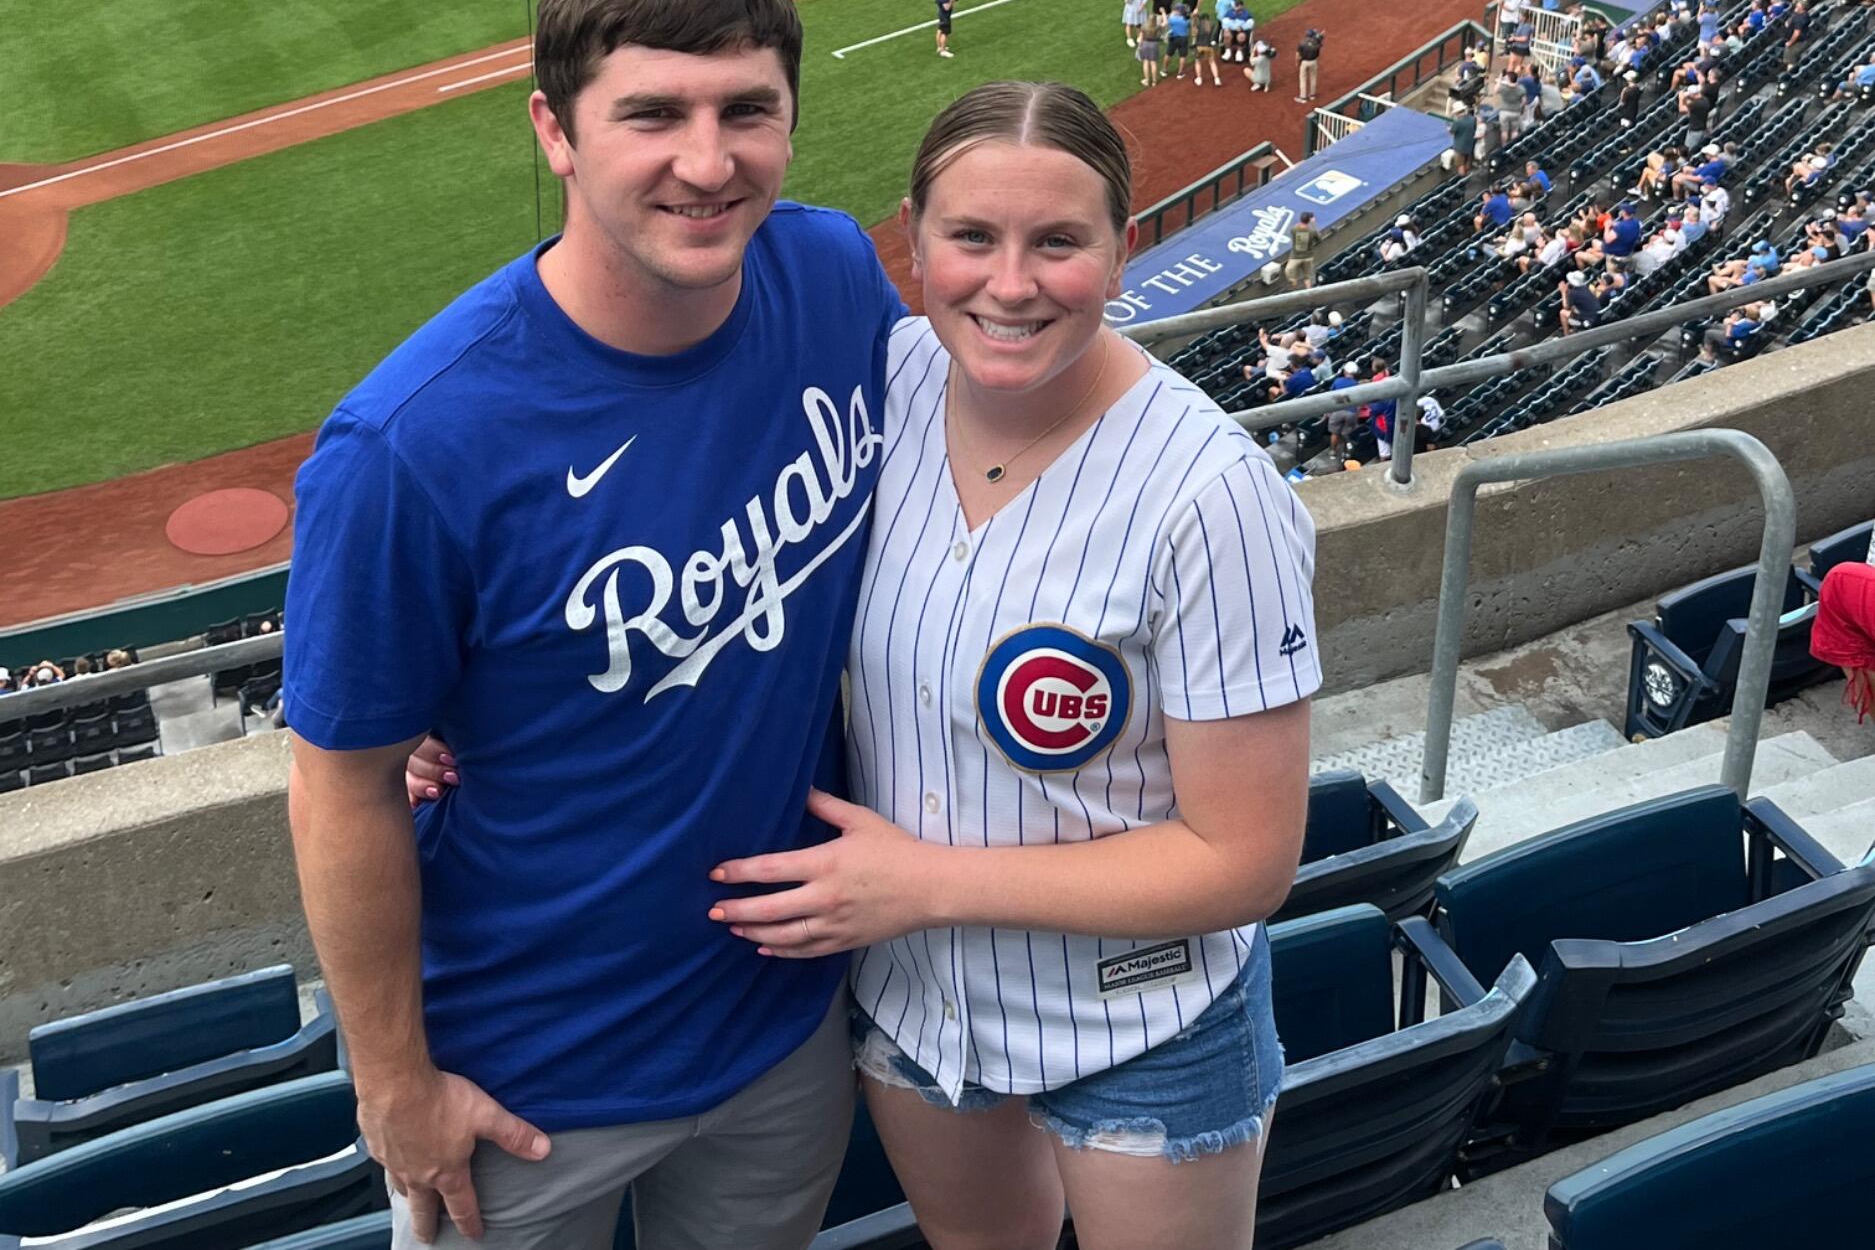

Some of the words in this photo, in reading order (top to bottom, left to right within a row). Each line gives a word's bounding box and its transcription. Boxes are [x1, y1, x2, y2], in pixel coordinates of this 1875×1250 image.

[1103, 288, 1152, 323] OF
[1141, 253, 1223, 295] THE
[1227, 205, 1295, 259] Royals
[565, 384, 884, 704] Royals
[1004, 656, 1108, 749] CUBS
[1127, 948, 1182, 972] Majestic
